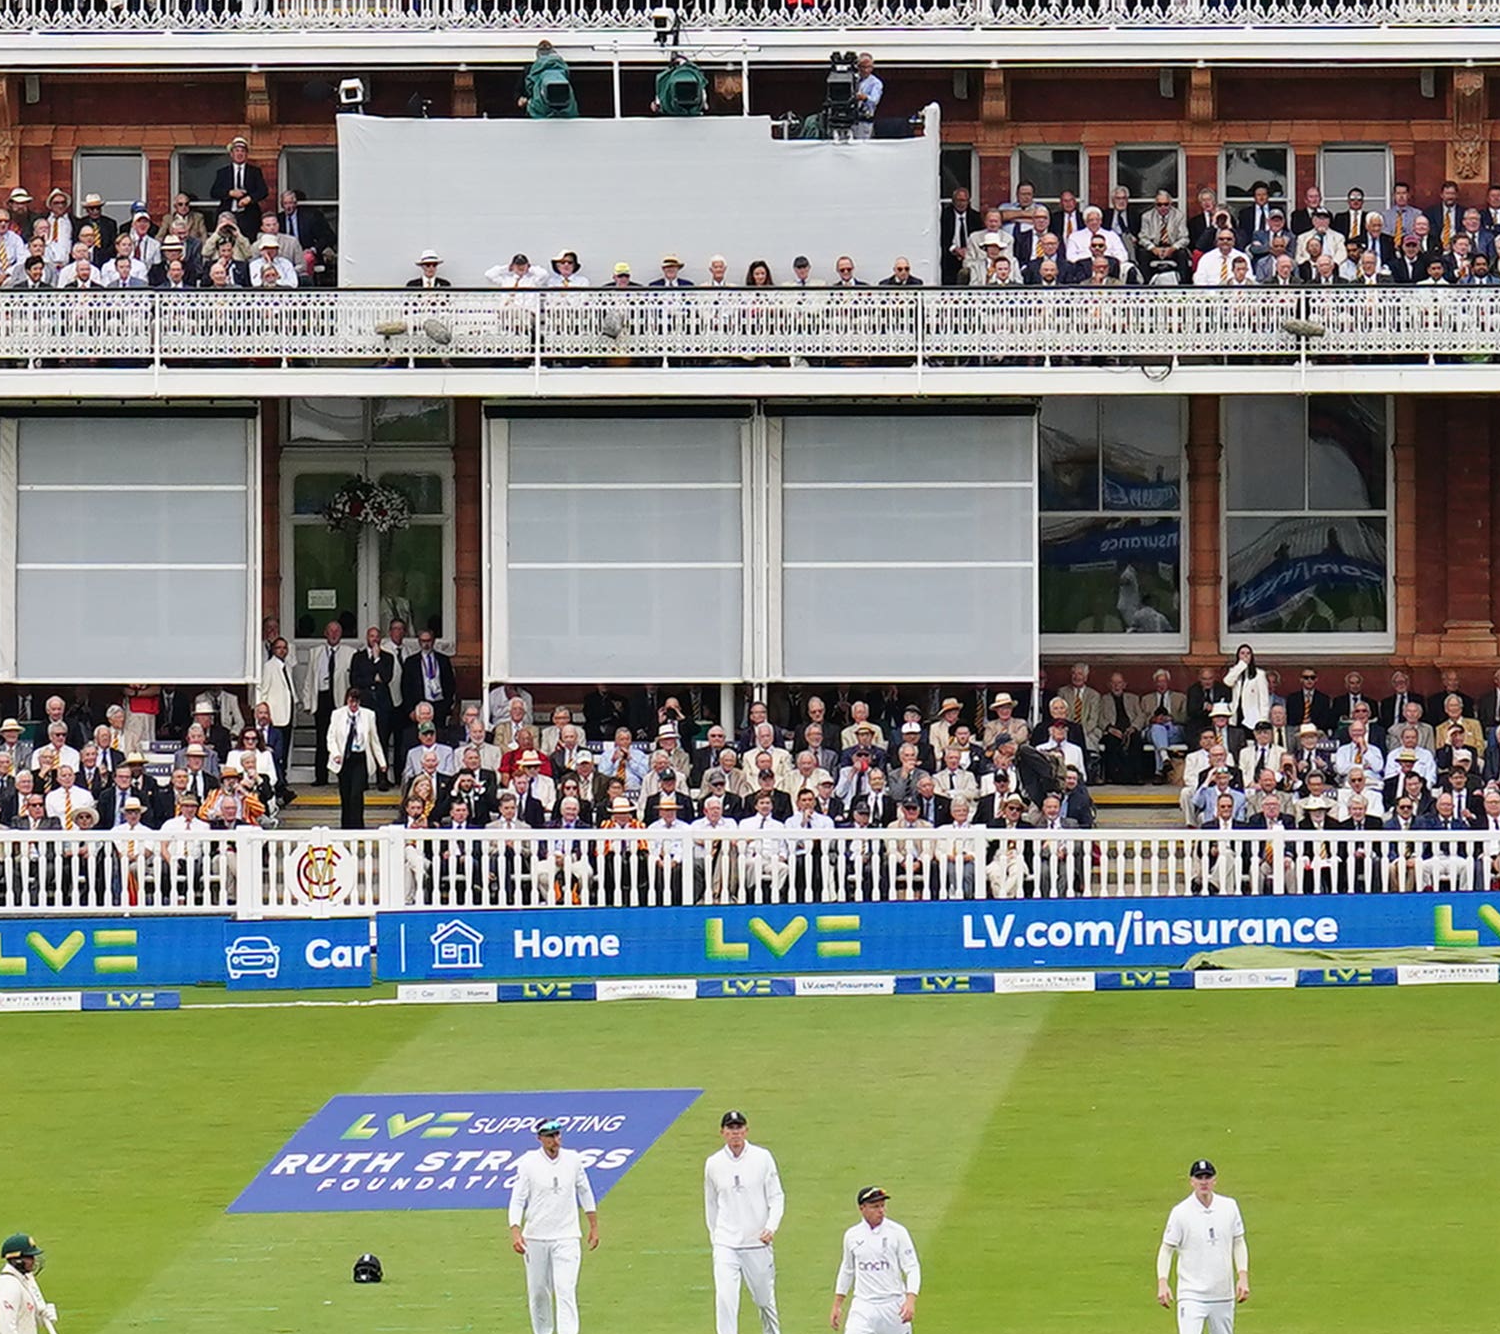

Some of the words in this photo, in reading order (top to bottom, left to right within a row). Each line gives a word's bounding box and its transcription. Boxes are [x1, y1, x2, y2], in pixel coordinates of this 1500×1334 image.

[513, 928, 620, 959] Home
[962, 910, 1338, 953] LV.com/insurance
[305, 938, 371, 969] Car
[270, 1151, 404, 1175] RUTH
[415, 1148, 634, 1173] STRSS
[316, 1175, 520, 1192] FOUNDATIO
